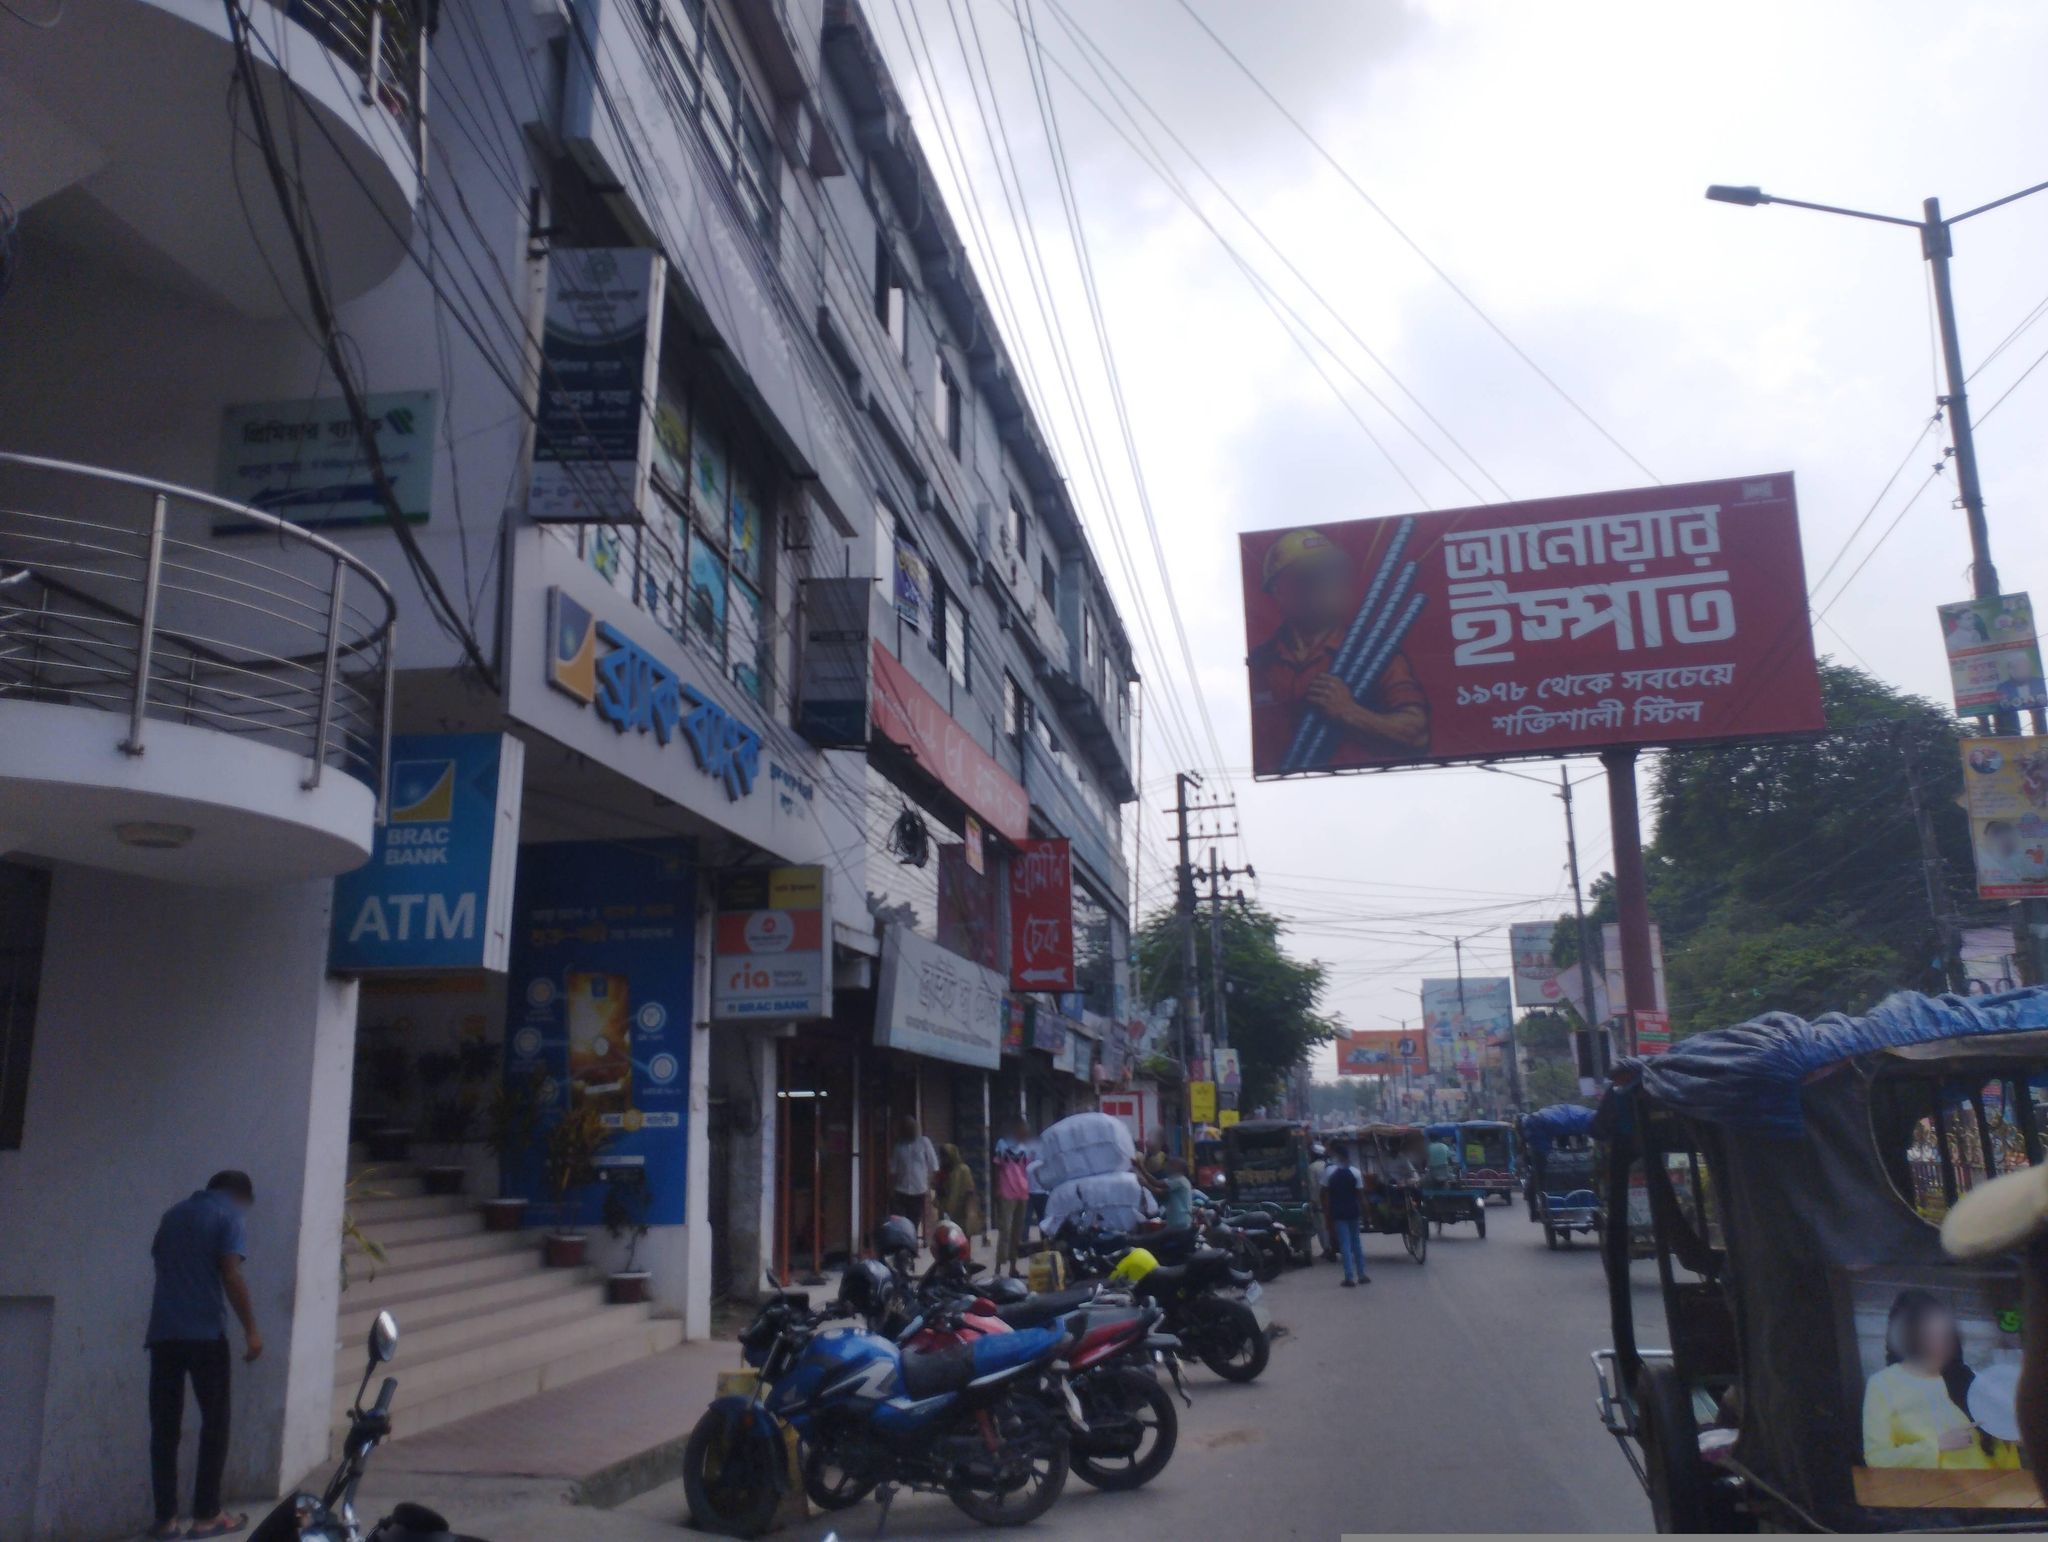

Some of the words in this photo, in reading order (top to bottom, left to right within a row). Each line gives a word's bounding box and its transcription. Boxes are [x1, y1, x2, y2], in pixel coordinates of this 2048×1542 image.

[1444, 504, 1721, 580] আনোয়ার
[1448, 570, 1737, 667] ইস্পাত
[1456, 681, 1529, 706] ১৯৭৮
[1537, 672, 1615, 700] থেকে
[1621, 663, 1735, 691] সবচেয়ে
[595, 620, 680, 747] ব্র্যাক
[680, 682, 762, 803] ব্যাংক
[1492, 698, 1625, 736] শক্তিশালী
[1632, 696, 1704, 726] স্টিল
[384, 846, 448, 865] BANK
[385, 826, 449, 846] BRAC
[350, 892, 476, 942] ATM
[729, 962, 770, 990] ria
[737, 1001, 772, 1013] BRAC
[773, 999, 810, 1012] BANK
